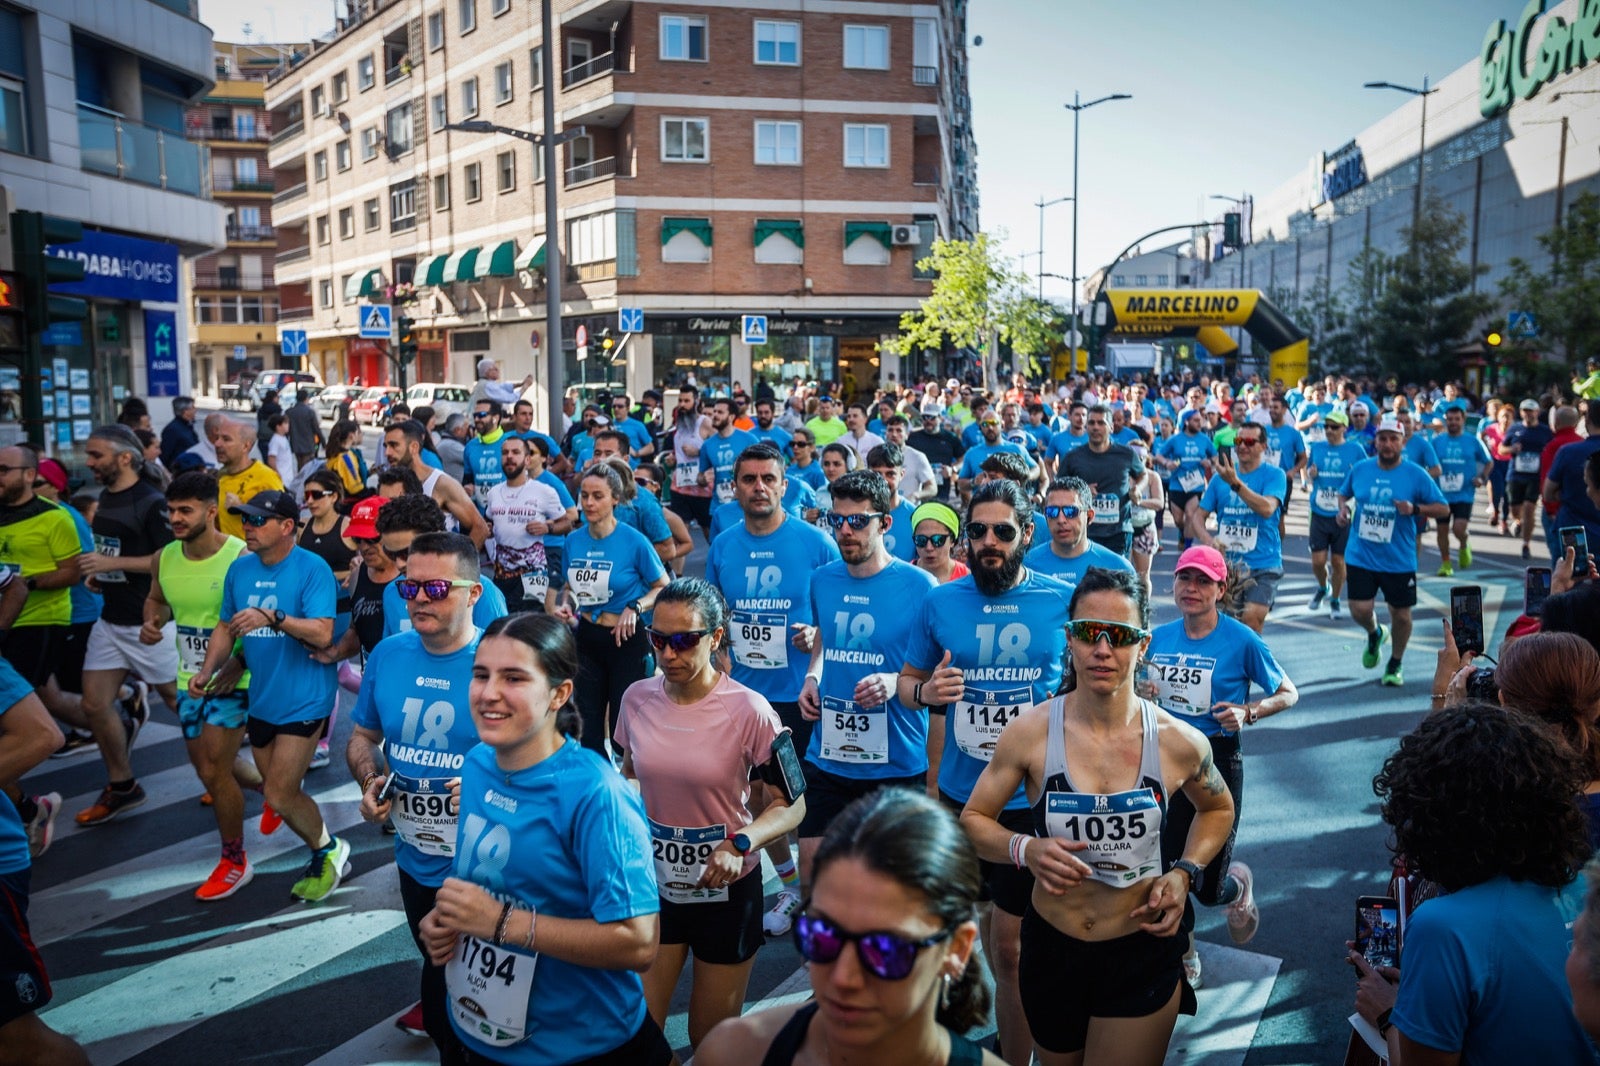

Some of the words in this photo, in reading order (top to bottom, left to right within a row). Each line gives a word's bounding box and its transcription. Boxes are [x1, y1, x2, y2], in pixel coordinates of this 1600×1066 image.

[1126, 296, 1240, 313] MARCELINO
[1225, 526, 1252, 537] 2218
[576, 569, 598, 582] 604
[744, 565, 783, 600] 18
[735, 599, 791, 610] MARCELINO
[742, 625, 772, 642] 605
[834, 610, 875, 651] 18
[976, 622, 1031, 667] 18
[825, 648, 885, 666] MARCELINO
[963, 667, 1042, 682] MARCELINO
[1160, 666, 1202, 685] 1235
[400, 697, 456, 750] 18
[835, 713, 870, 732] 543
[976, 726, 988, 734] LUIS
[389, 743, 465, 770] MARCELINO
[399, 812, 433, 825] FRANCISCO
[1065, 813, 1147, 842] 1035
[1103, 842, 1132, 852] CLARA
[462, 936, 516, 986] 1794
[467, 974, 487, 991] ALICIA
